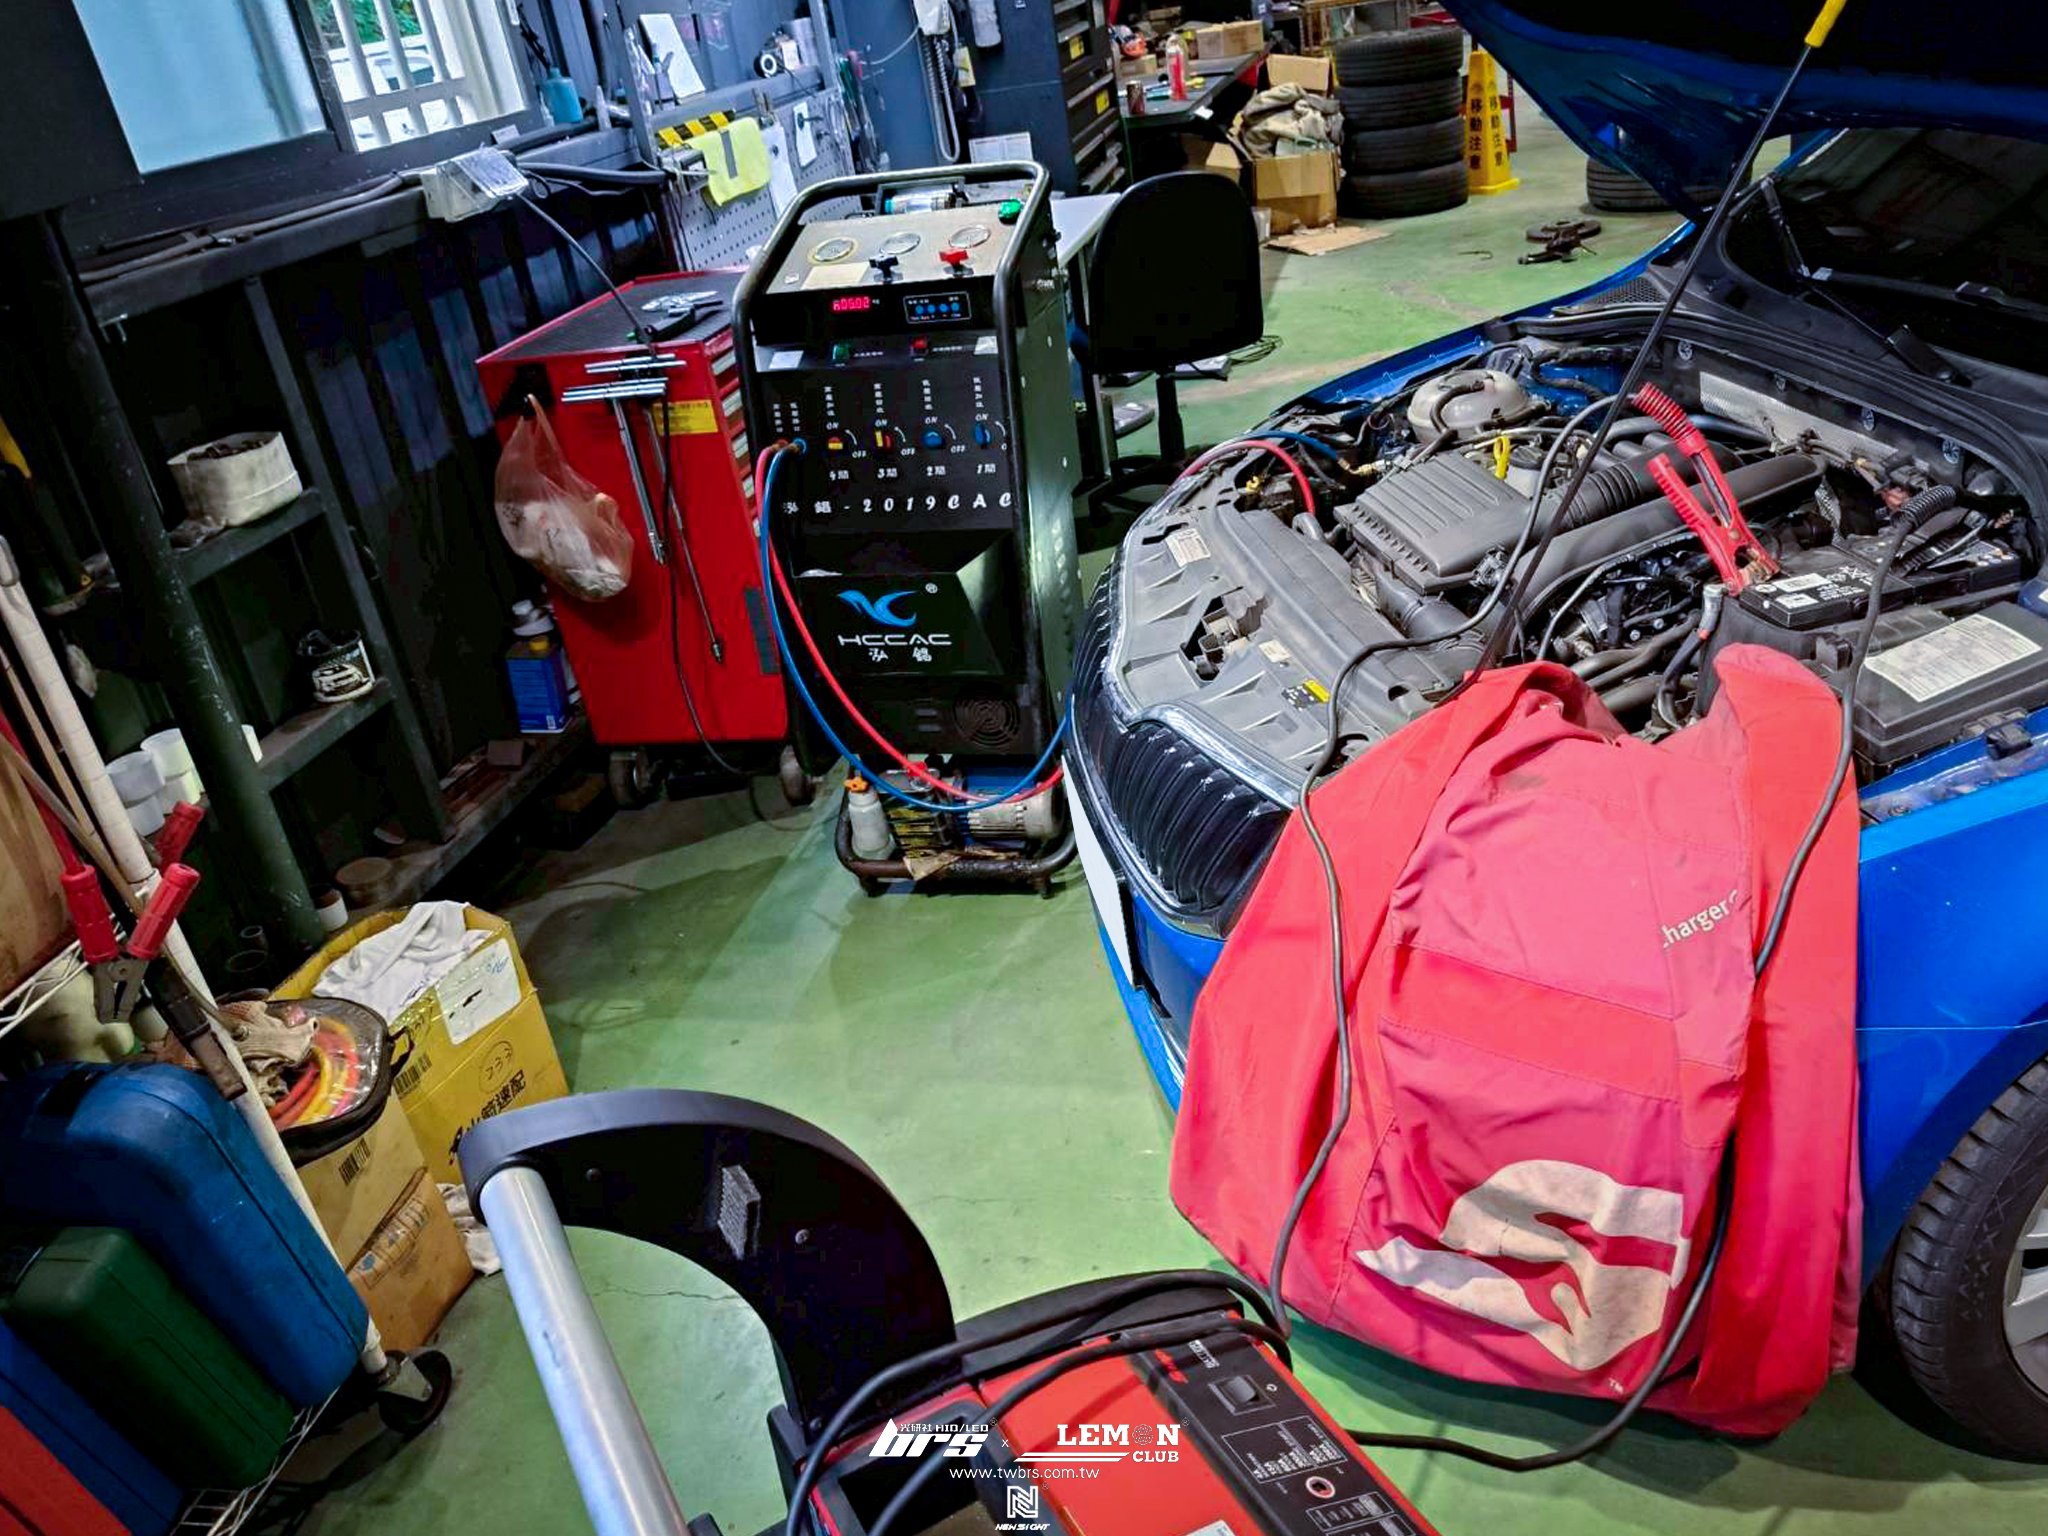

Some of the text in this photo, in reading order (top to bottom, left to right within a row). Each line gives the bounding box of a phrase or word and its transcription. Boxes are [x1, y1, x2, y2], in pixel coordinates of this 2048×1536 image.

[925, 416, 938, 424] ON
[826, 422, 839, 430] ON
[837, 634, 952, 646] HCCAC
[1662, 899, 1730, 949] harger
